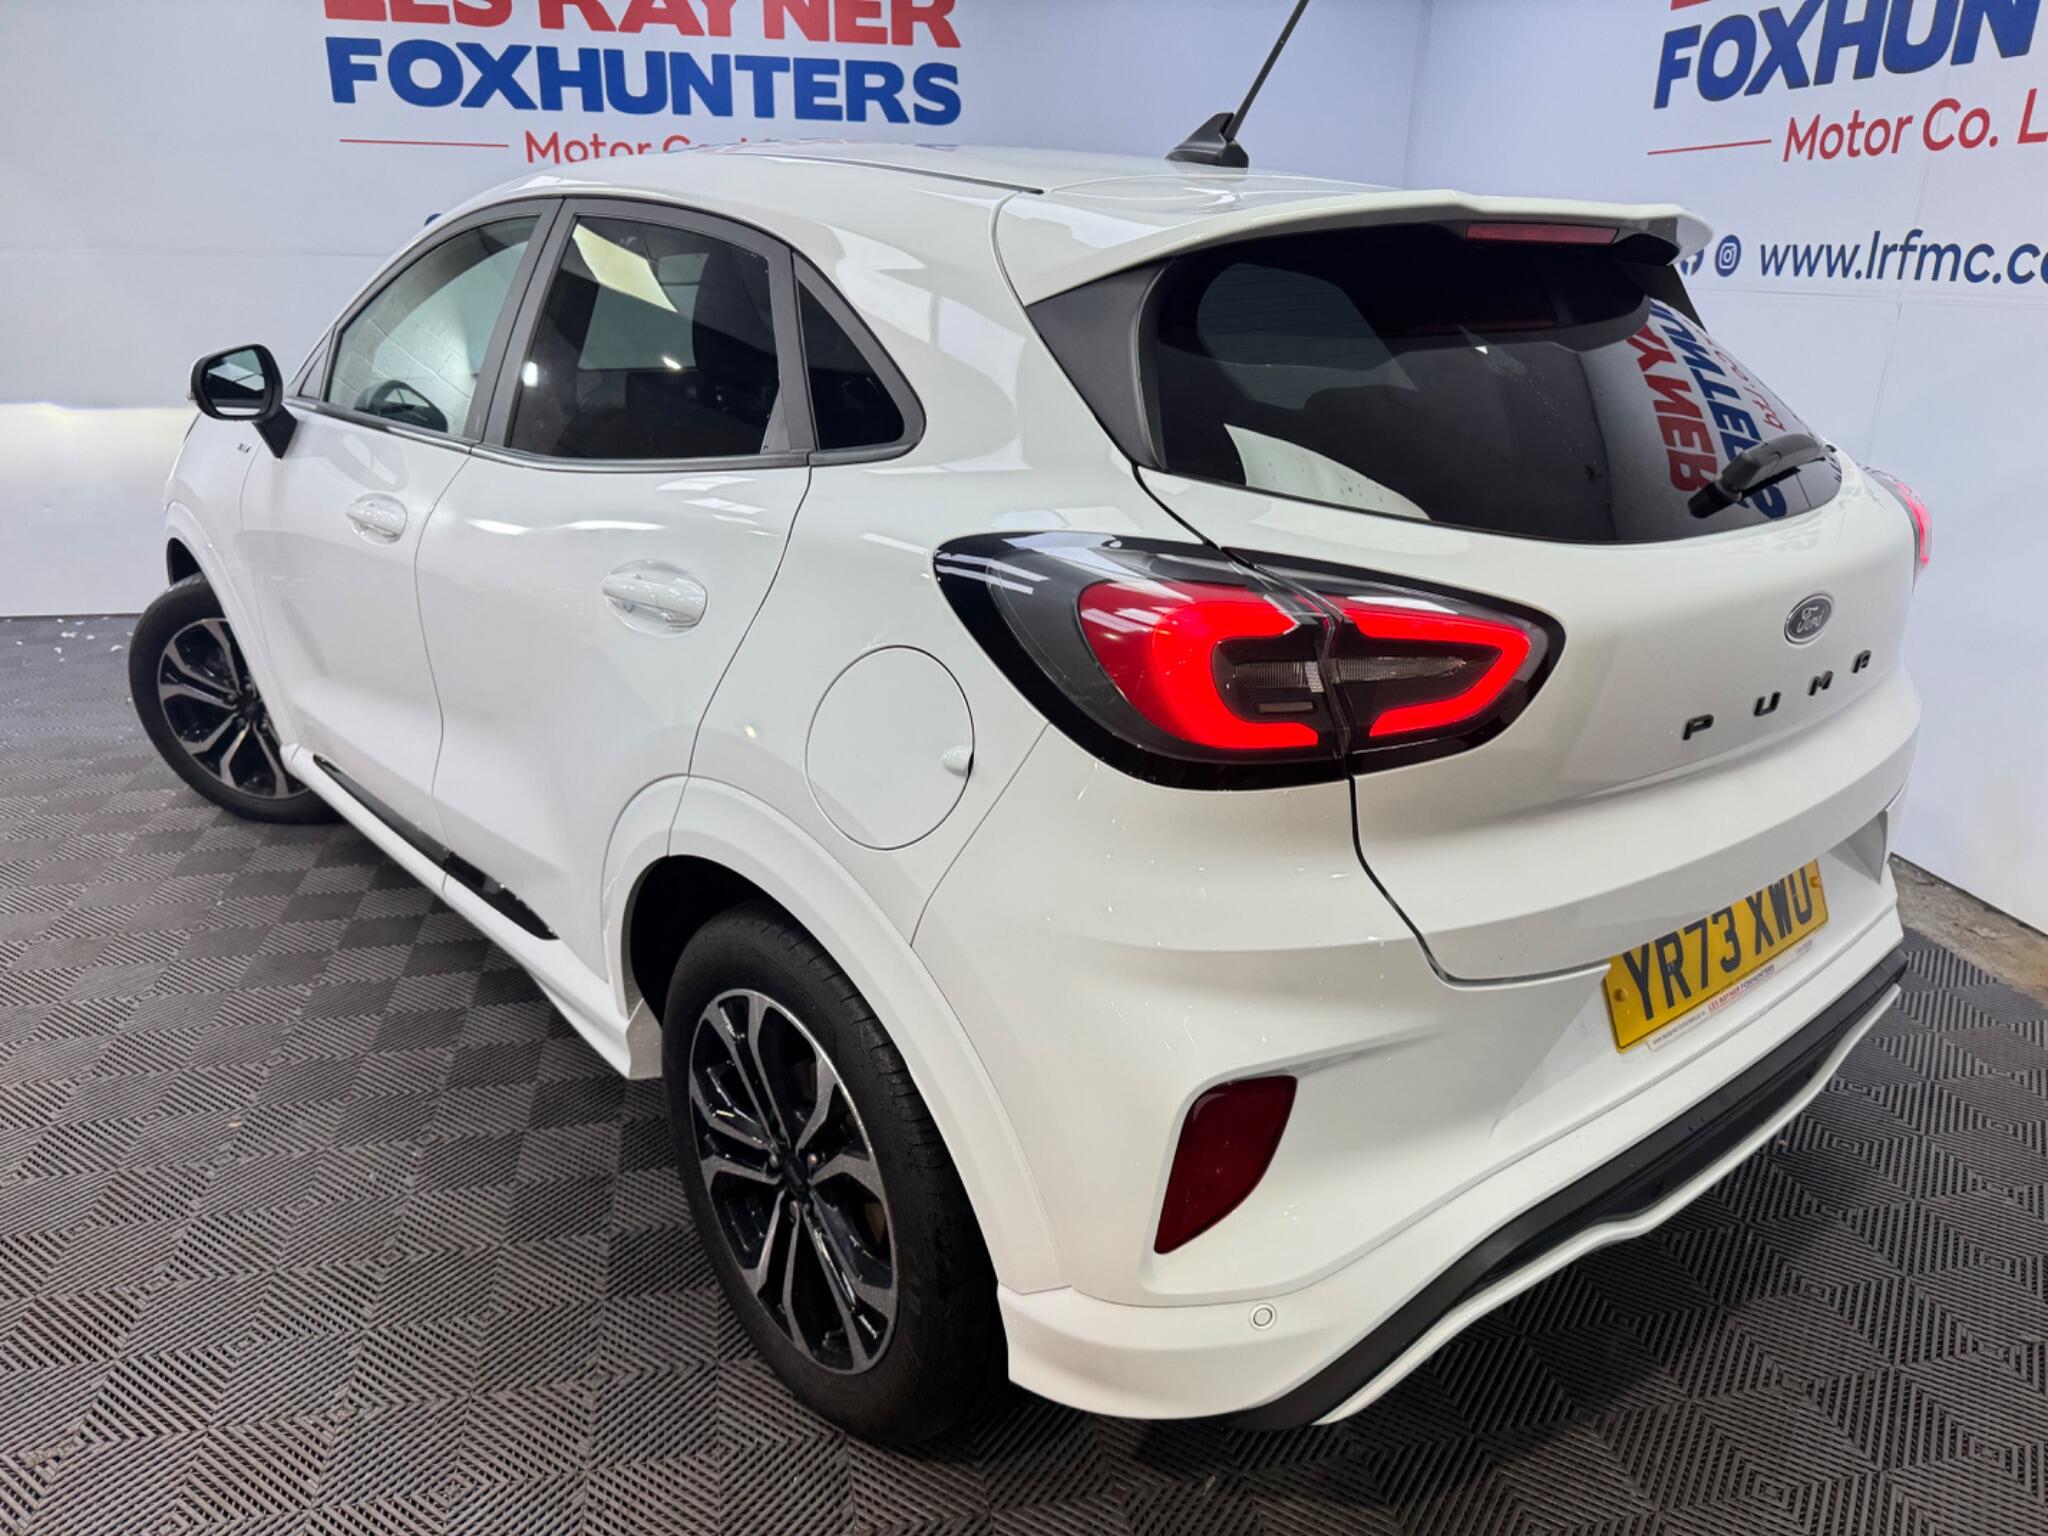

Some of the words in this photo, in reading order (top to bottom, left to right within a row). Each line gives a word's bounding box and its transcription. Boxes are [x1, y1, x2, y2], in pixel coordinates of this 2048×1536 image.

[326, 36, 962, 126] FOXHUNTERS
[1653, 0, 2041, 109] FOXHUN
[1783, 110, 1914, 162] Motor
[1922, 97, 1999, 151] Co.
[1759, 228, 2048, 285] www.lrfmc.c
[1797, 605, 1824, 634] Ford
[1682, 650, 1872, 741] PUMA
[1622, 906, 1742, 1022] YR73
[1745, 866, 1813, 956] XWU
